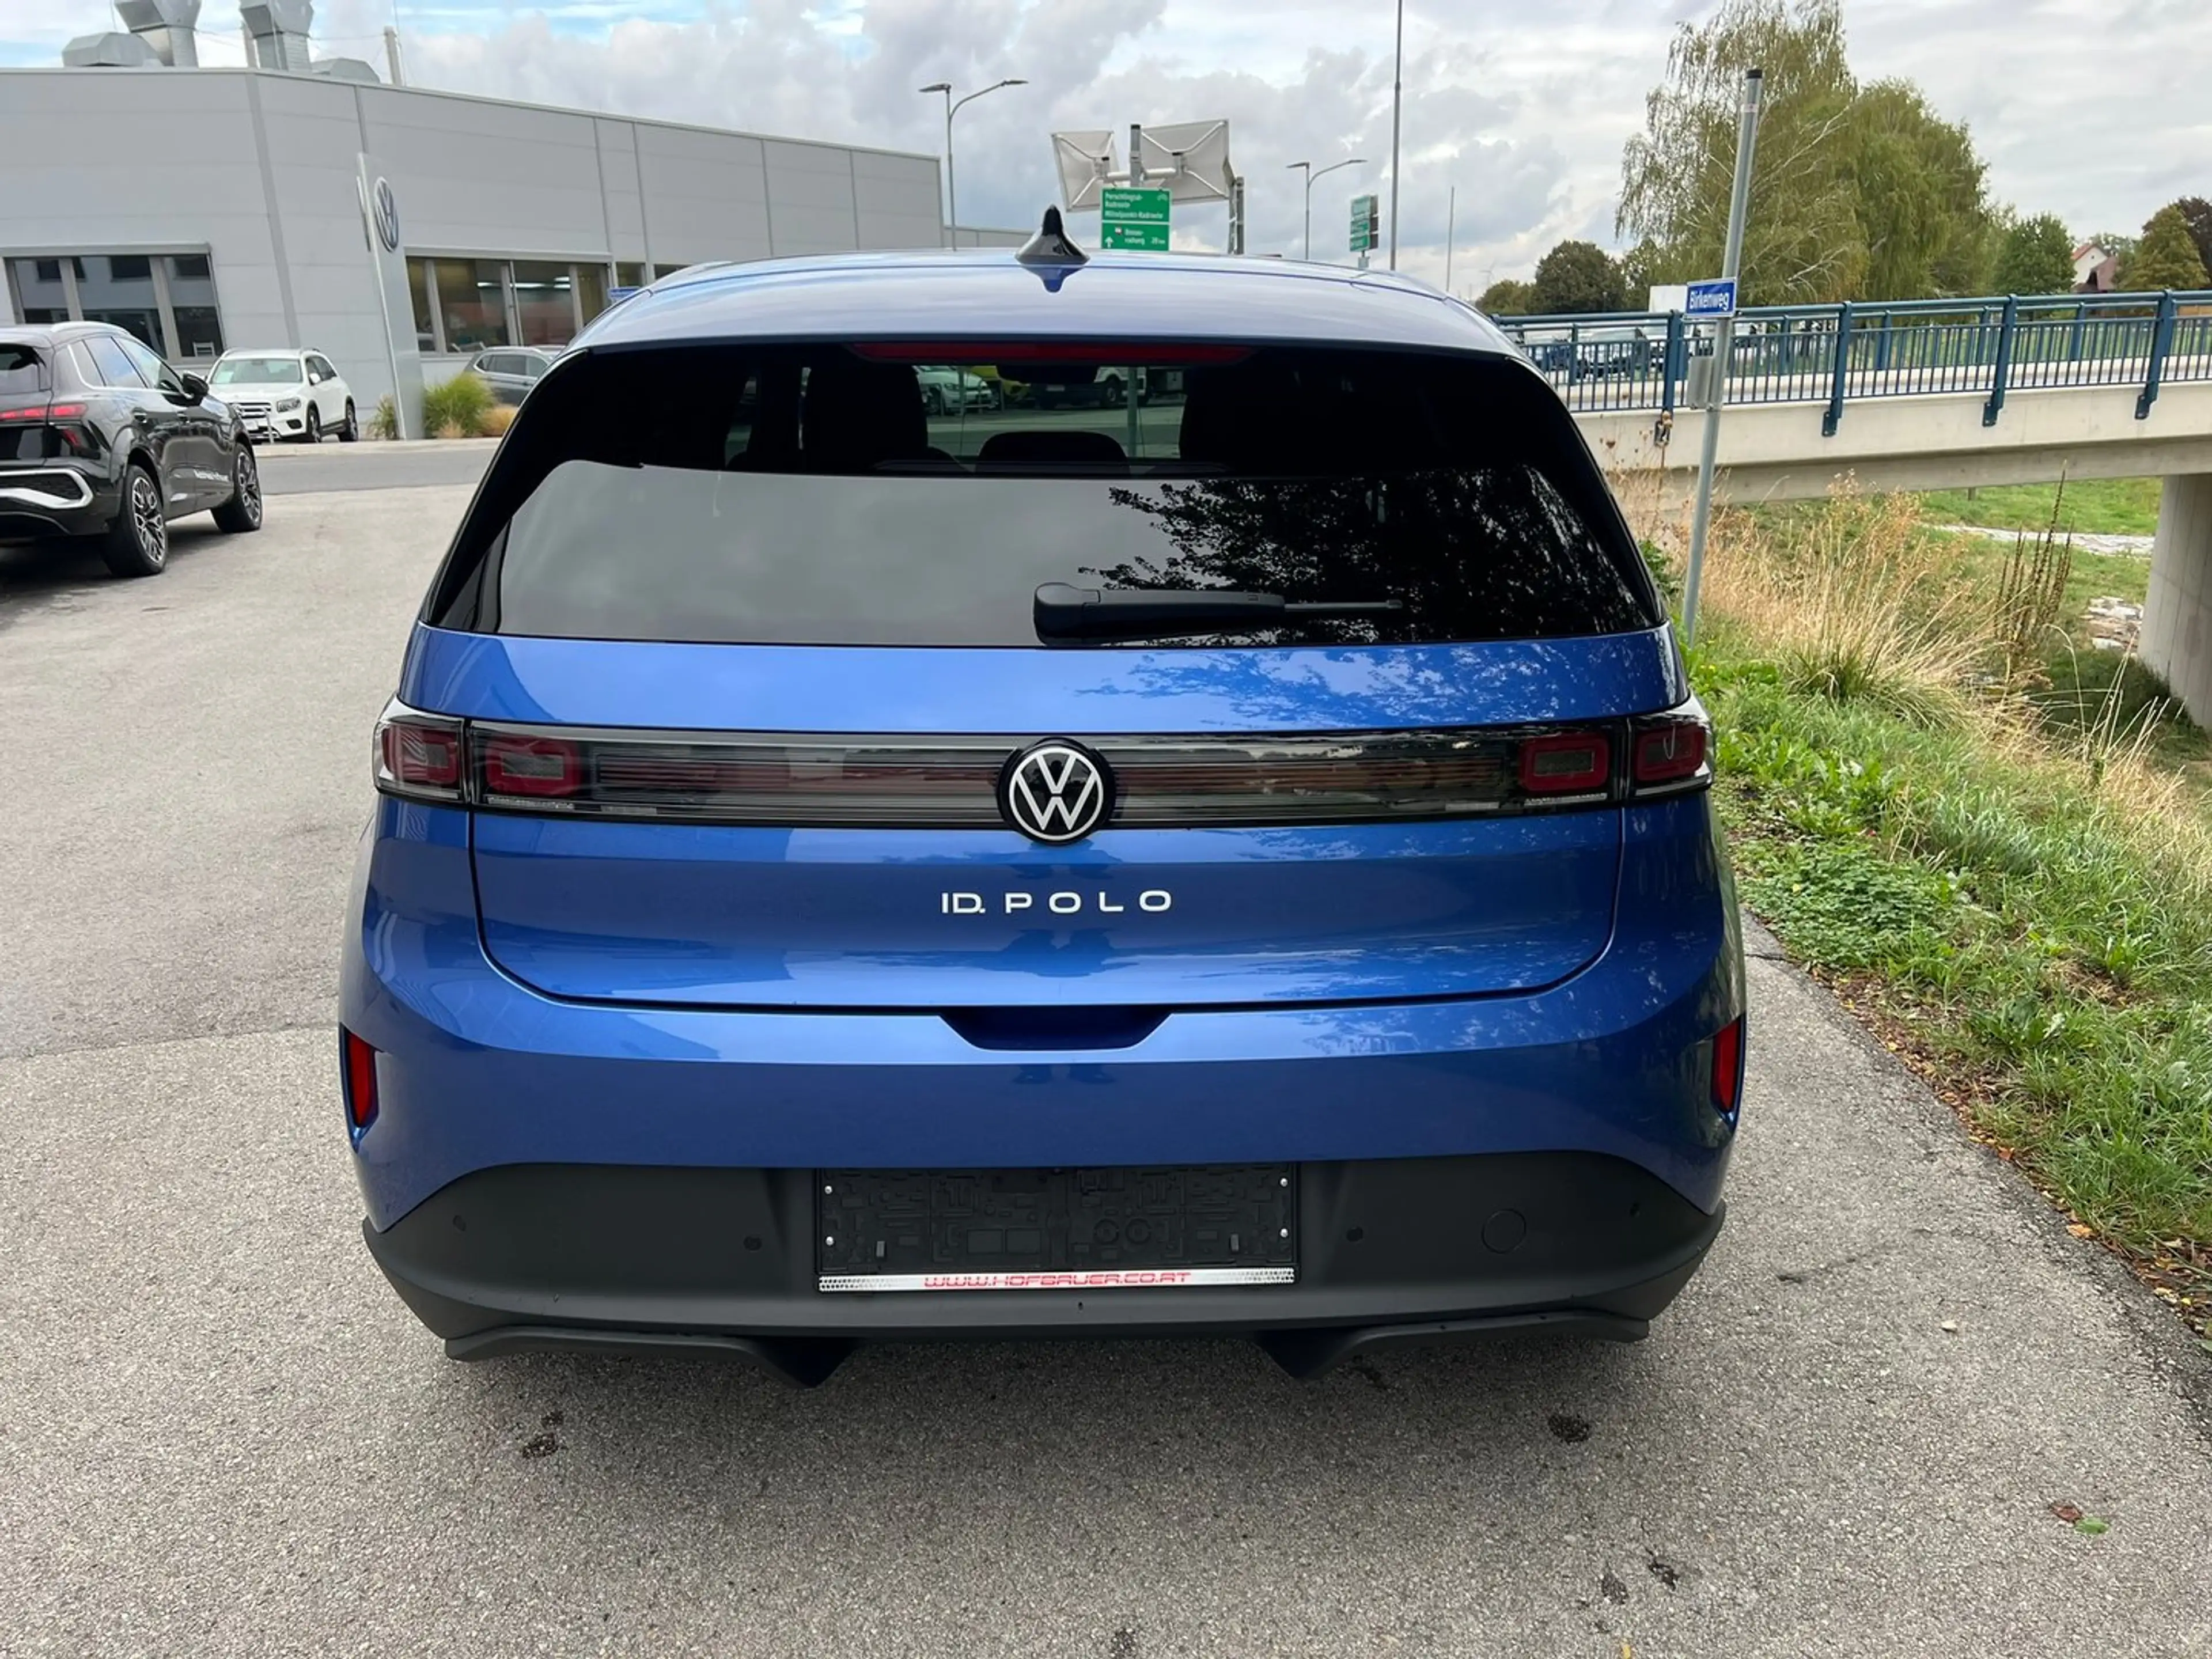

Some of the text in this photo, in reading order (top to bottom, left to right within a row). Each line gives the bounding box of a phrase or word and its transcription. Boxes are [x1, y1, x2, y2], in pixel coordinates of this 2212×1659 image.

[1690, 290, 1729, 311] Birkenweg
[941, 890, 1172, 914] ID. POLO
[924, 1272, 1191, 1287] WWW.HOFBAUER.CO.AT
